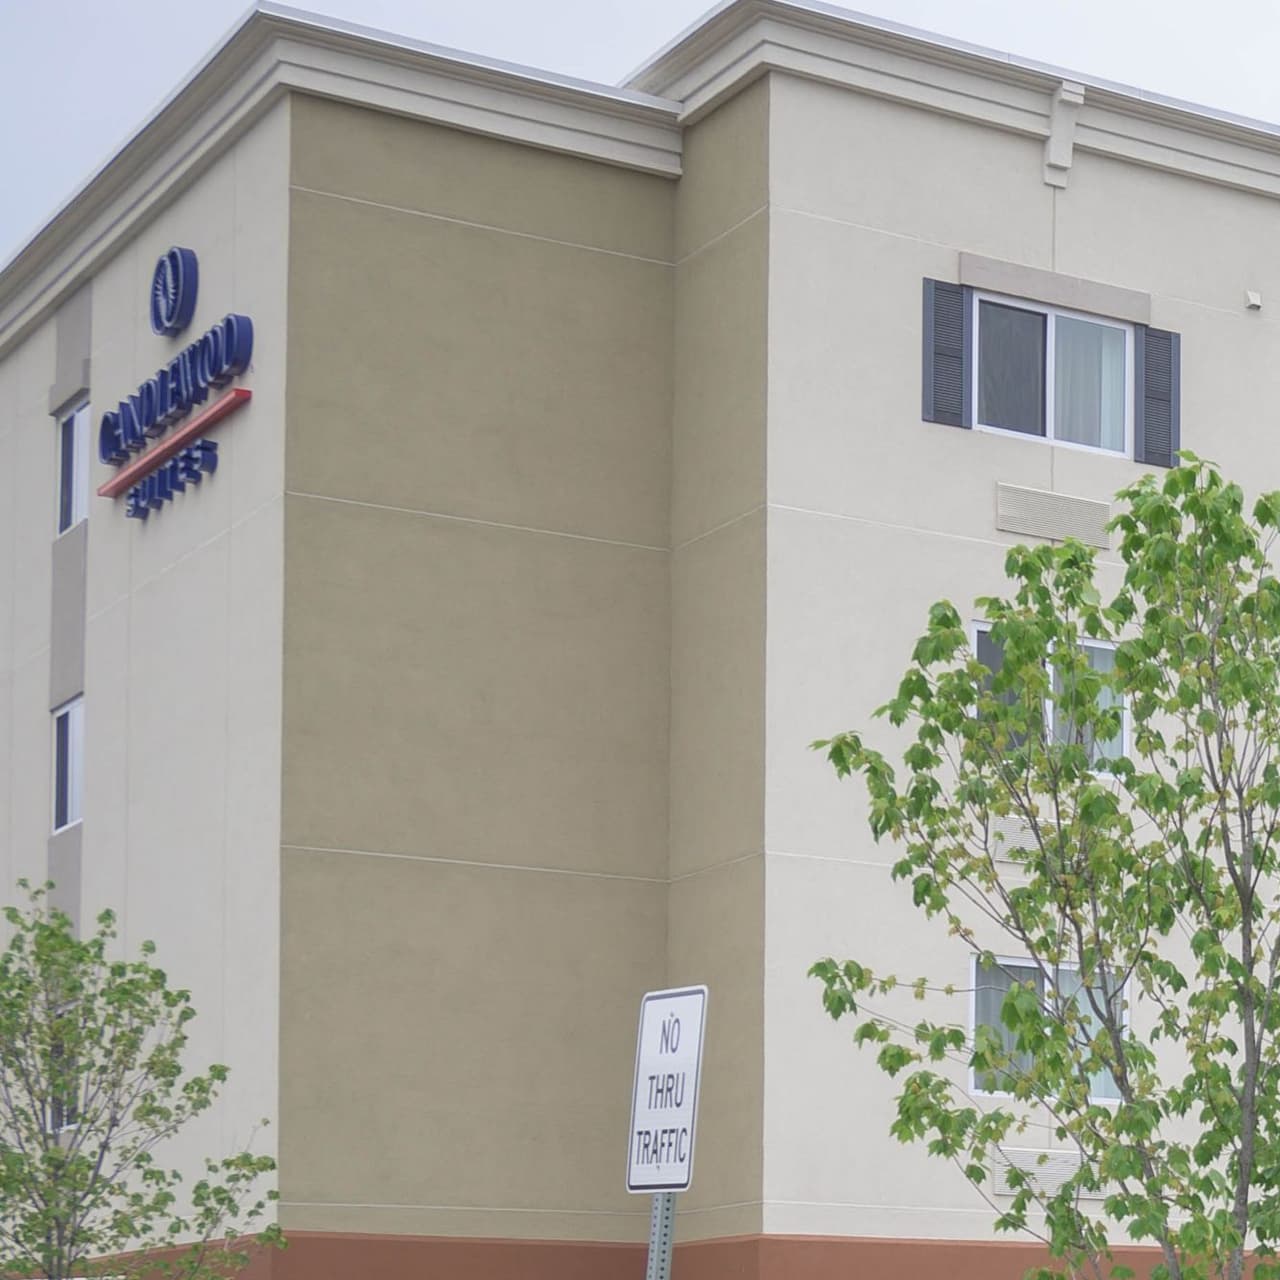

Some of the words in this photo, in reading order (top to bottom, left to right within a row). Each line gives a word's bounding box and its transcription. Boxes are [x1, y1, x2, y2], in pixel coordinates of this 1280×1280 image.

[659, 1017, 681, 1054] NO
[648, 1072, 685, 1109] THRU
[636, 1127, 688, 1165] TRAFFIC
